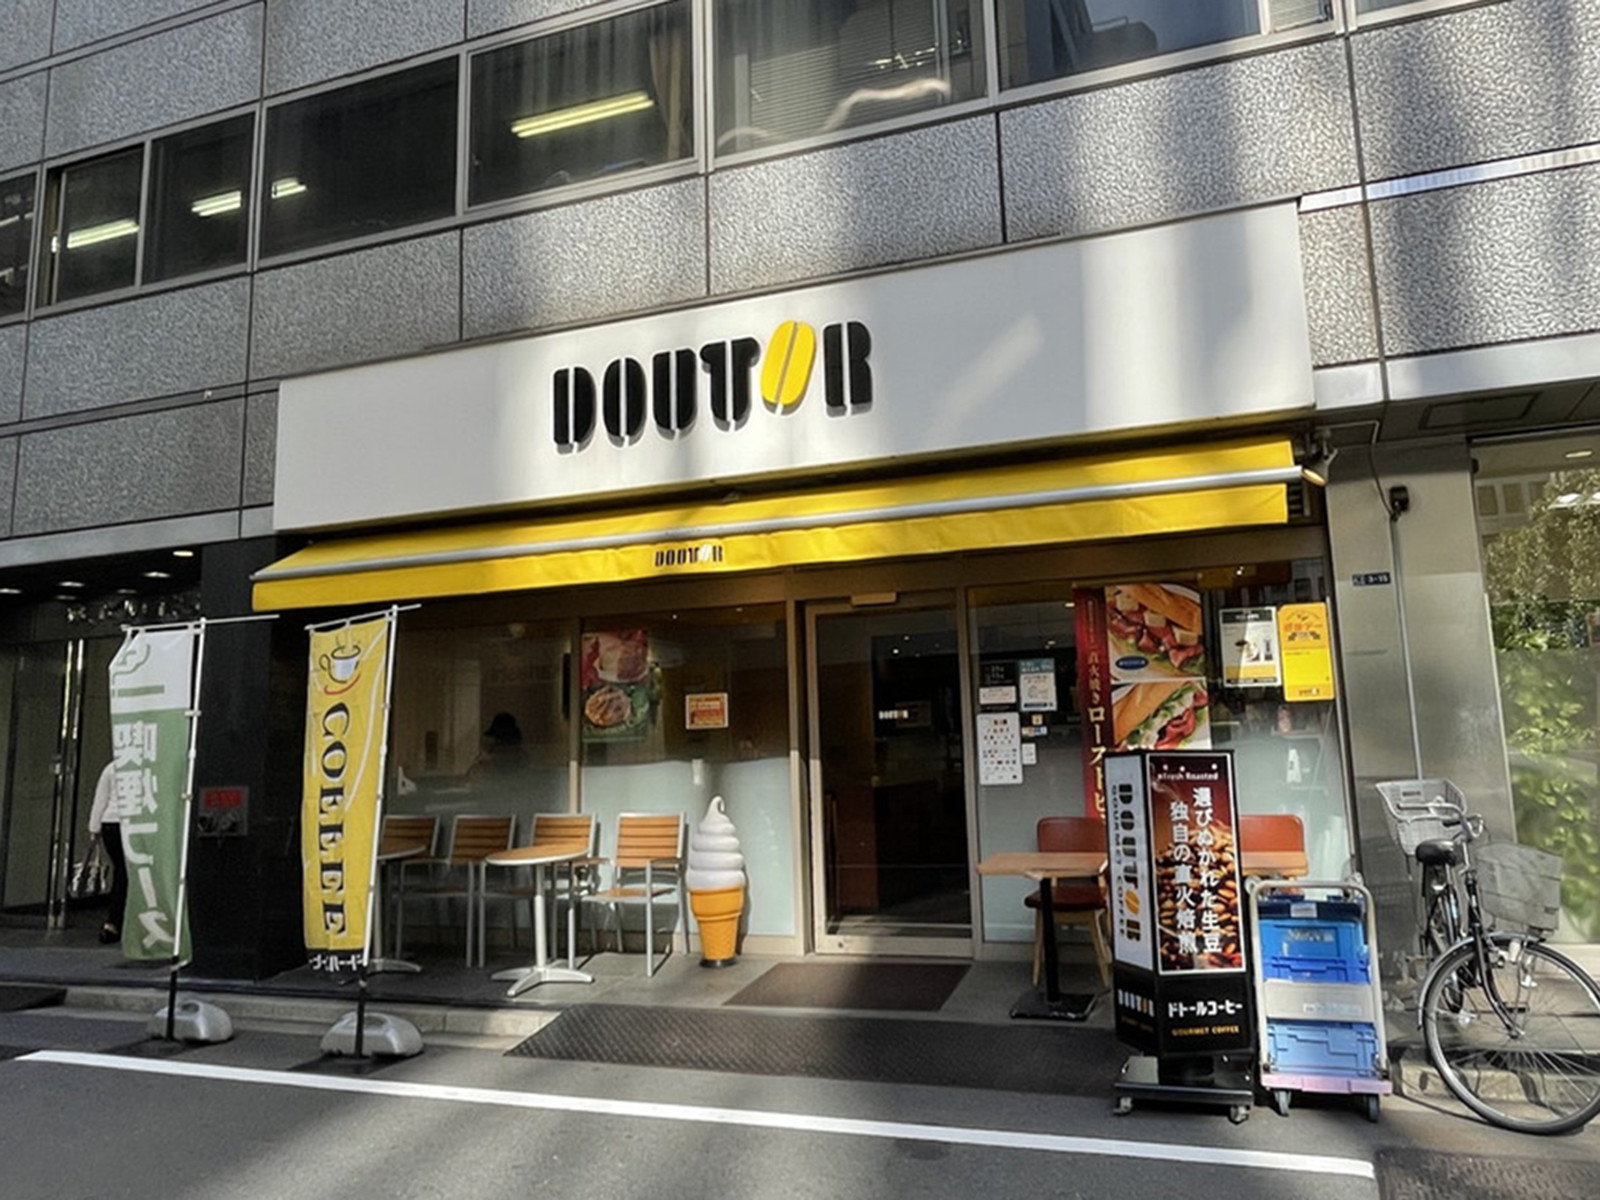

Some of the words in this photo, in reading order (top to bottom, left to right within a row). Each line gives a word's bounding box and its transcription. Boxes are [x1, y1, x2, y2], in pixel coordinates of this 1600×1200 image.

[553, 320, 873, 454] DOUTOR
[655, 545, 722, 566] DOUTOR
[1119, 784, 1141, 942] DOUTOR
[1193, 787, 1222, 953] 選びぬかれた生豆
[1168, 999, 1243, 1018] ドトールコーヒー
